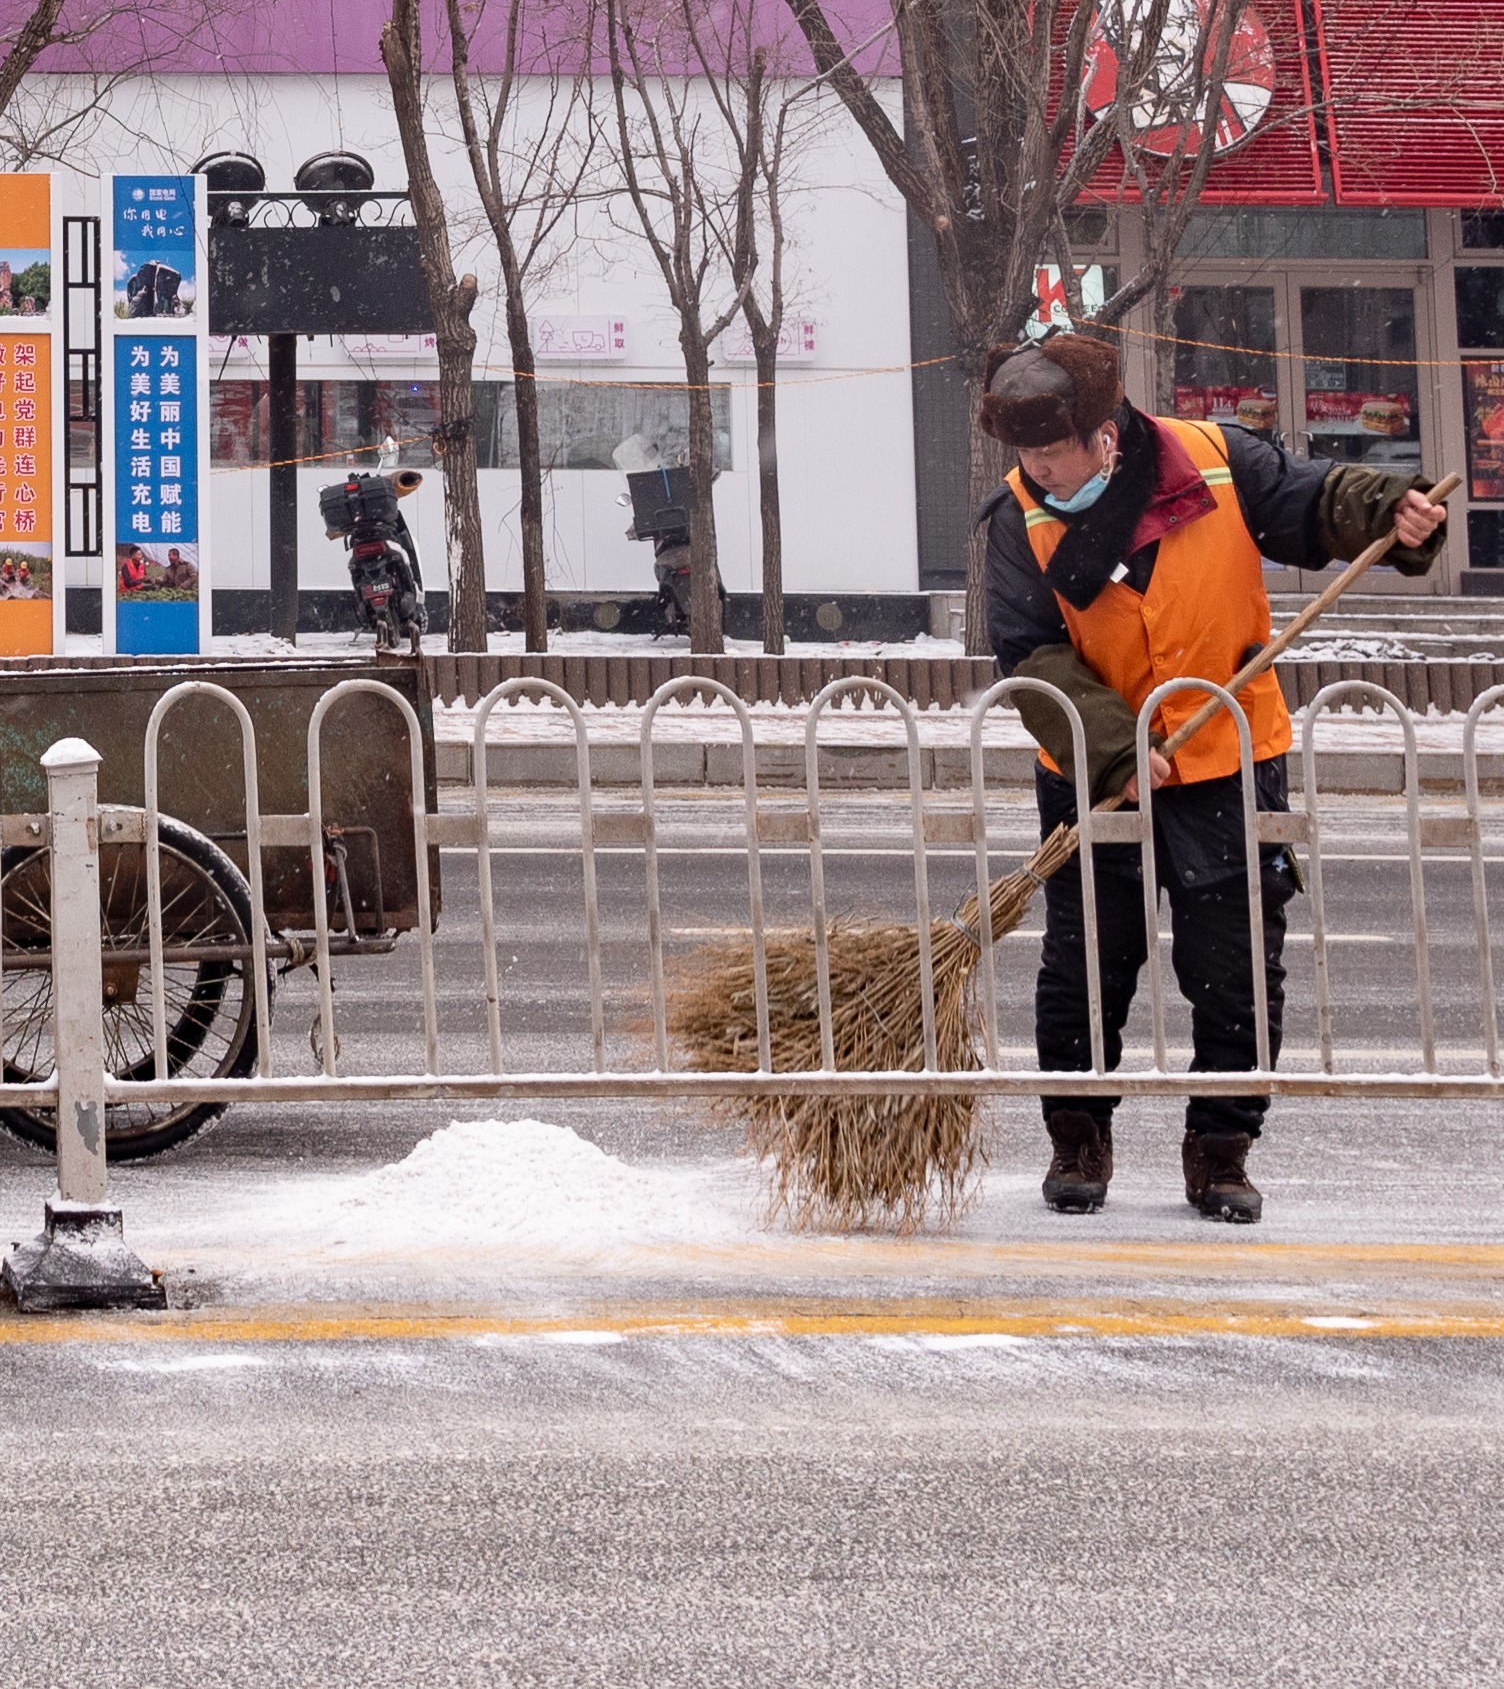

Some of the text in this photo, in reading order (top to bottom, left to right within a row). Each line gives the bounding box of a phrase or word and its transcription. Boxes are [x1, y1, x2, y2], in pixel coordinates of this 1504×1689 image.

[12, 344, 37, 533] 架起党群连心桥
[129, 345, 153, 534] 为美好生活充电
[159, 345, 183, 534] 为美丽中国赋能
